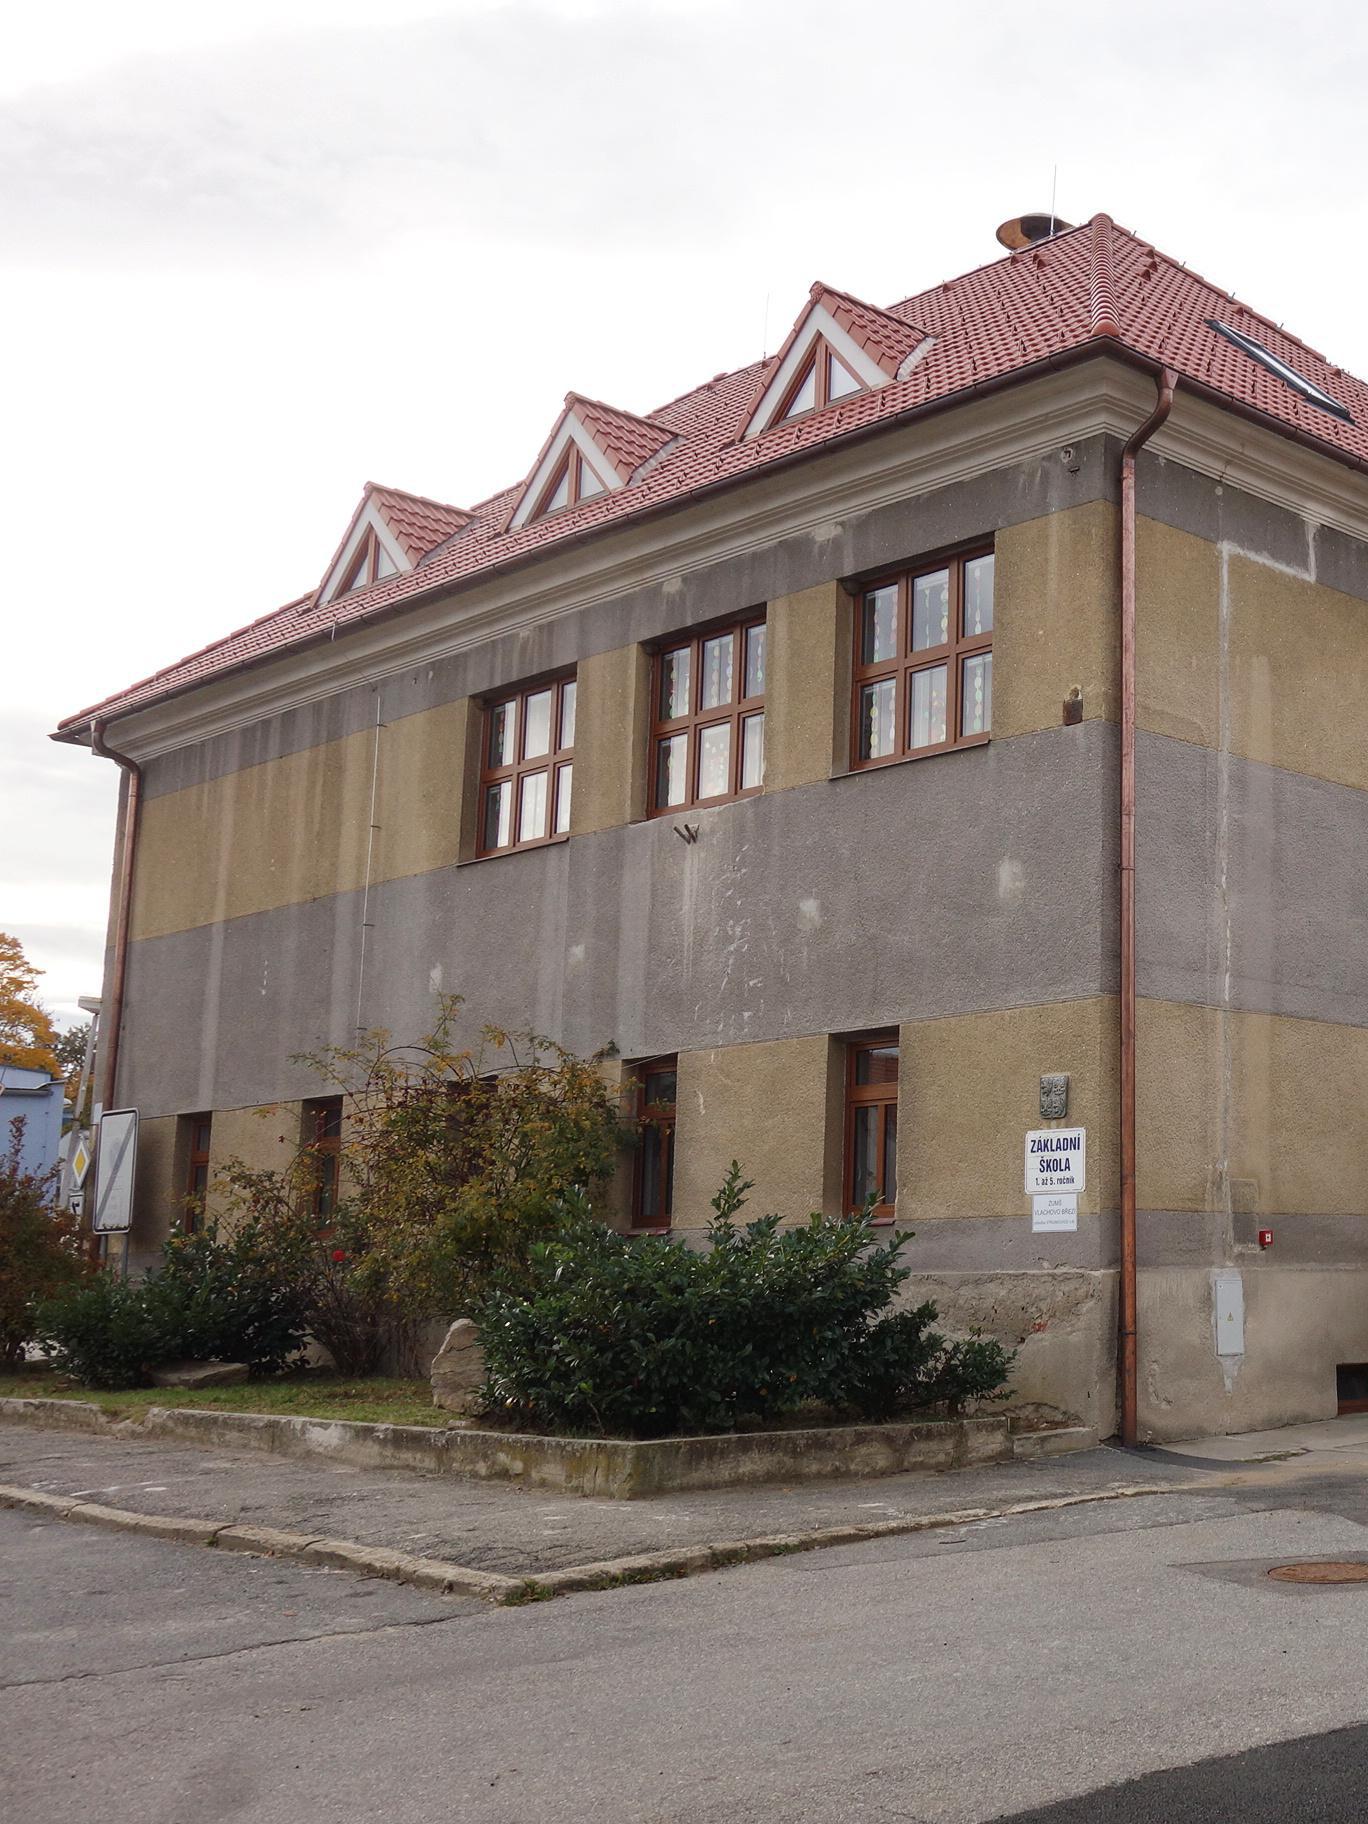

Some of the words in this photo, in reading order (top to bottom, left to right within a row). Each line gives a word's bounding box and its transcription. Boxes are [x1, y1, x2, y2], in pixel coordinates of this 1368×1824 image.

[1030, 1133, 1080, 1153] ZÁKLADNÍ
[1039, 1156, 1071, 1173] ŠKOLA
[1035, 1178, 1040, 1186] 1.
[1041, 1177, 1048, 1185] až
[1049, 1177, 1056, 1185] 5.
[1056, 1175, 1075, 1184] ročník
